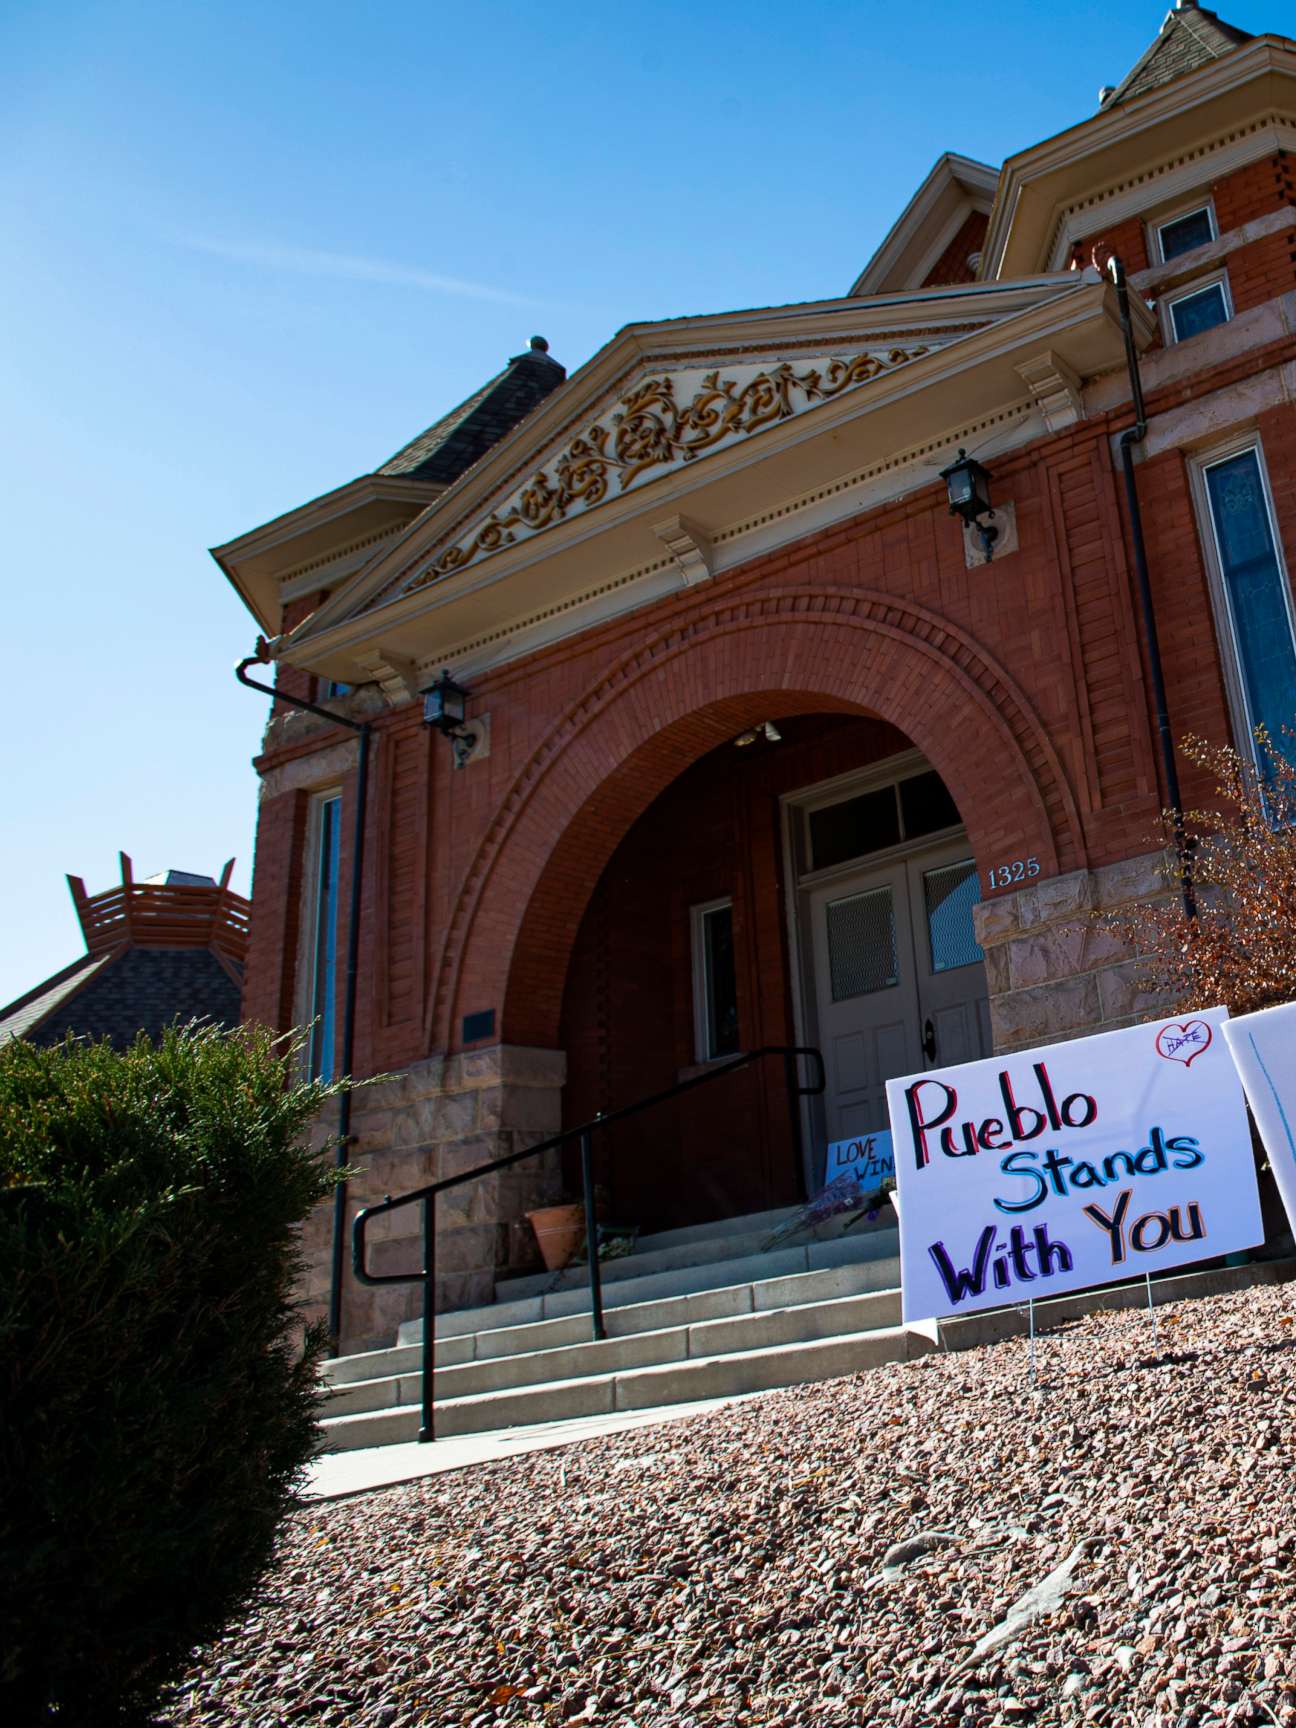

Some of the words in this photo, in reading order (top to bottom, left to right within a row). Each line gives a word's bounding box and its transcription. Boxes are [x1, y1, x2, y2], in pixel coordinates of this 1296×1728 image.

[988, 857, 1041, 890] 1325
[904, 1061, 1098, 1170] Pueblo
[836, 1136, 877, 1166] LOVE
[854, 1156, 896, 1181] WIN
[993, 1126, 1206, 1215] Stands
[927, 1222, 1074, 1306] With
[1082, 1188, 1208, 1266] You
